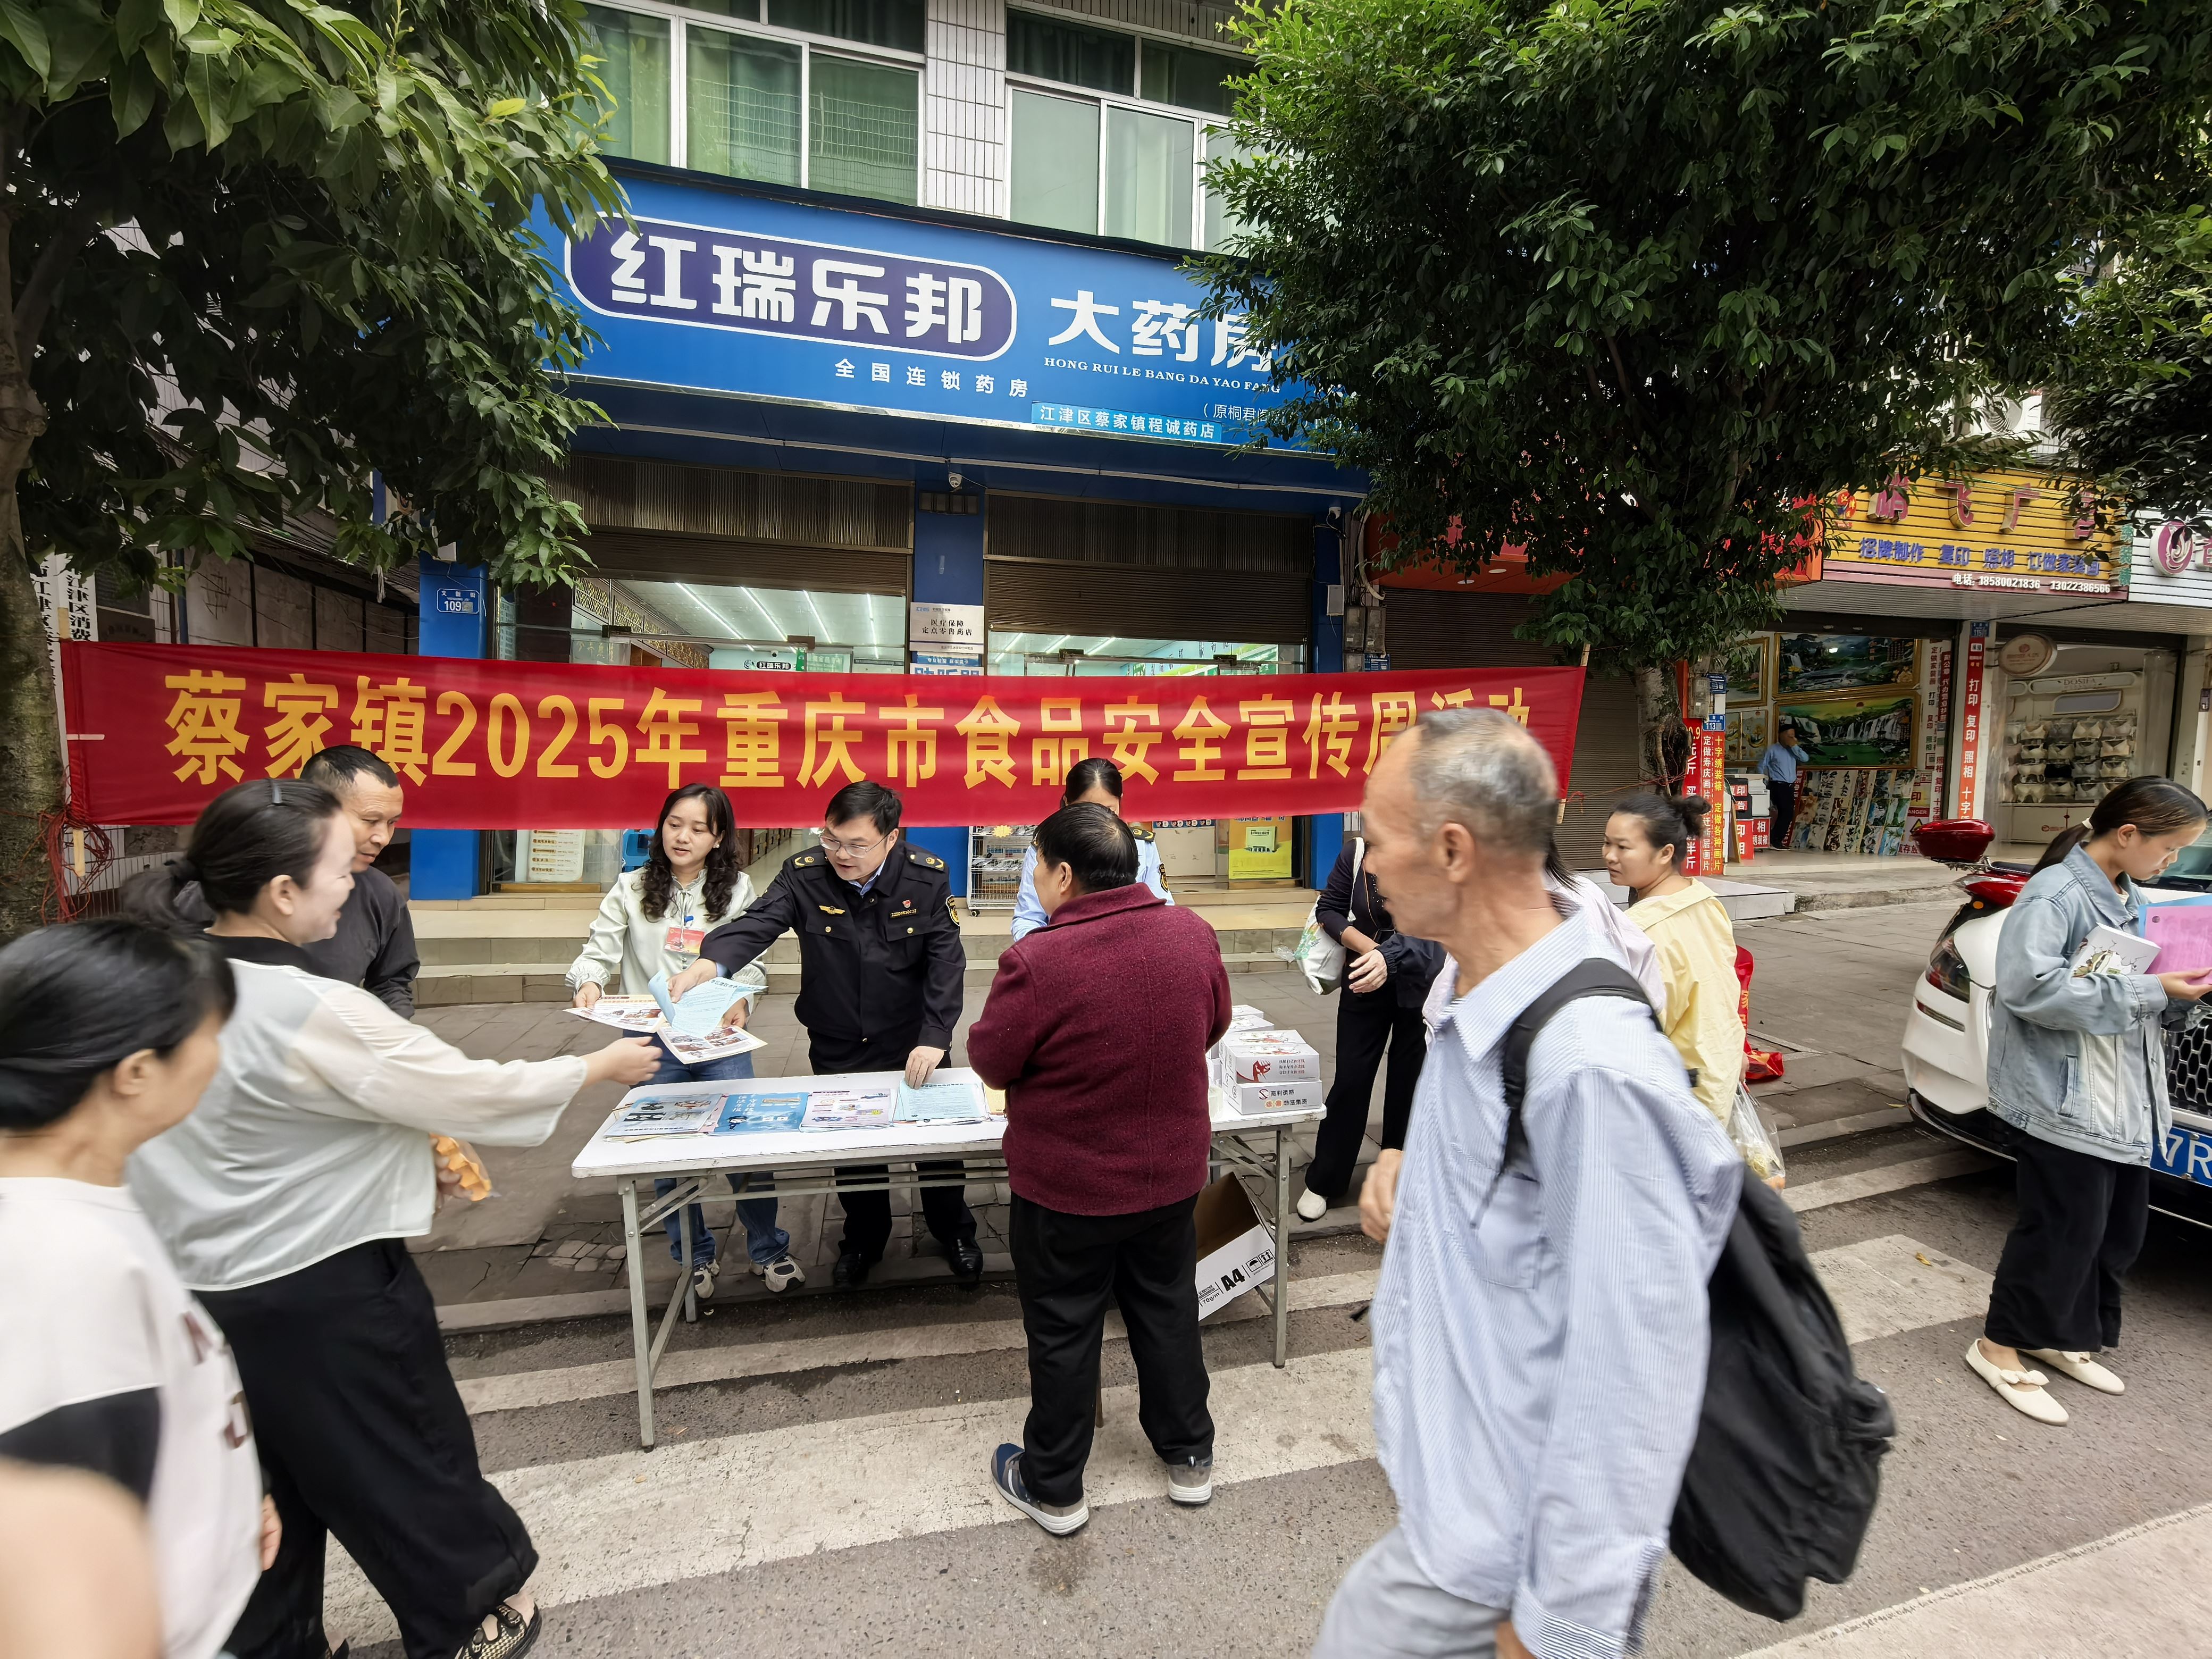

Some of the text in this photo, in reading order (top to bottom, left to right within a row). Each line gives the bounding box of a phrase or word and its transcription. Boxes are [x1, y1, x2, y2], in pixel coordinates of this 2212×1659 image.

[610, 230, 982, 344] 红瑞乐邦
[834, 358, 1028, 398] 全国连锁药房
[1044, 357, 1088, 371] HONG
[1092, 363, 1119, 375] RUI
[1122, 366, 1141, 378] LE
[1146, 369, 1185, 383] BANG
[1189, 374, 1210, 387] DA
[1212, 378, 1241, 389] YAO
[1040, 405, 1215, 439] 江津区蔡家镇程诚药店
[1859, 537, 1925, 564] 招牌制作
[1938, 543, 1971, 567] 复印
[1982, 548, 2015, 569] 照相
[1978, 575, 2041, 589] 18580021836
[2050, 580, 2111, 593] 13022386566
[443, 600, 462, 612] 109
[922, 627, 973, 636] 定点零售药店
[931, 619, 964, 627] 医疗保障
[759, 661, 790, 670] 红瑞乐邦
[1928, 692, 1936, 707] 打印
[1968, 678, 1980, 707] 打印
[165, 669, 1530, 791] 蔡家镇2025年重庆市食品安全宣传周
[1965, 715, 1976, 742] 复印
[1703, 735, 1712, 799] 定做寿庆画片
[1963, 751, 1974, 778] 照相
[1713, 735, 1723, 871] 十字绣装裱 定做各种画片
[1220, 1268, 1245, 1292] A4
